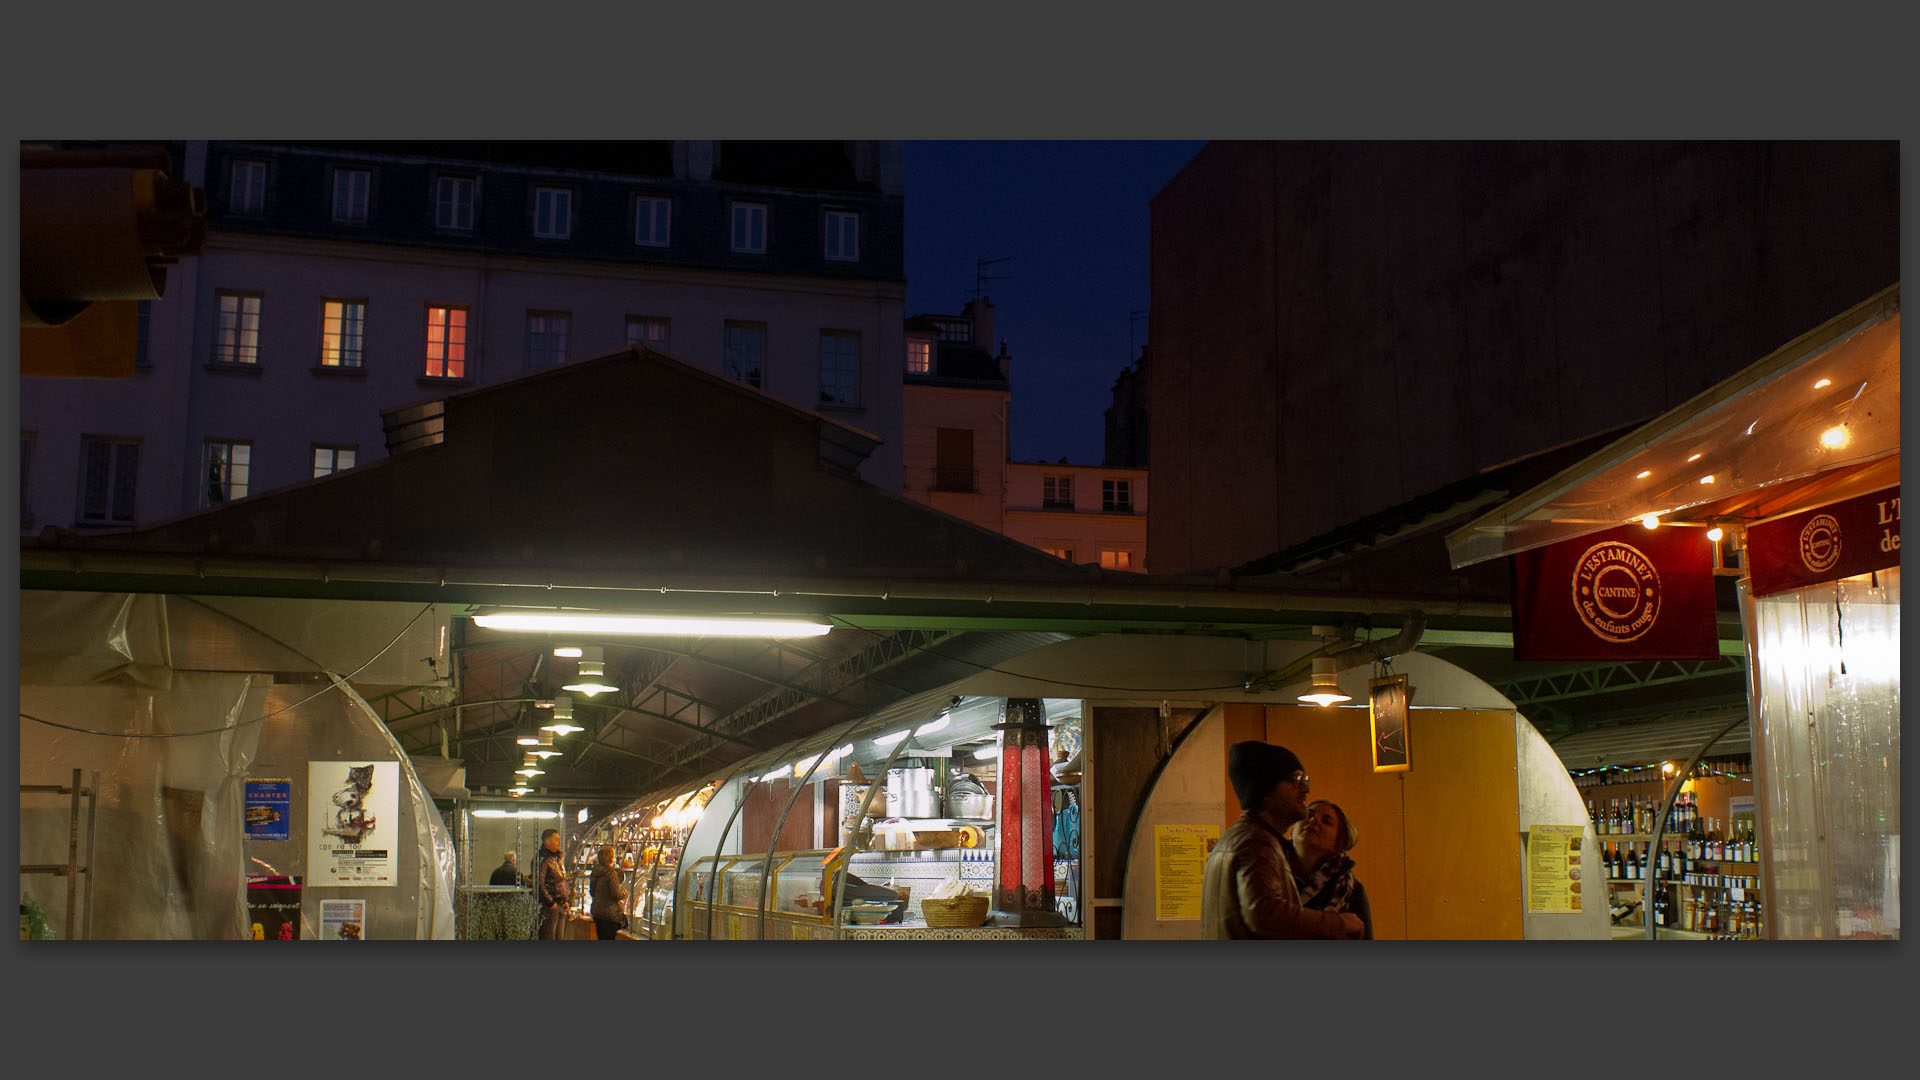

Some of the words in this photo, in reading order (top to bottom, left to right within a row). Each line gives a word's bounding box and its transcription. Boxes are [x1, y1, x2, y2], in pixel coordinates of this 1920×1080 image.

[1581, 548, 1653, 581] L'ESTAMINET
[1599, 587, 1637, 598] CANTINE
[1583, 600, 1597, 619] des
[1595, 617, 1630, 634] enfants
[1631, 602, 1654, 631] rouges
